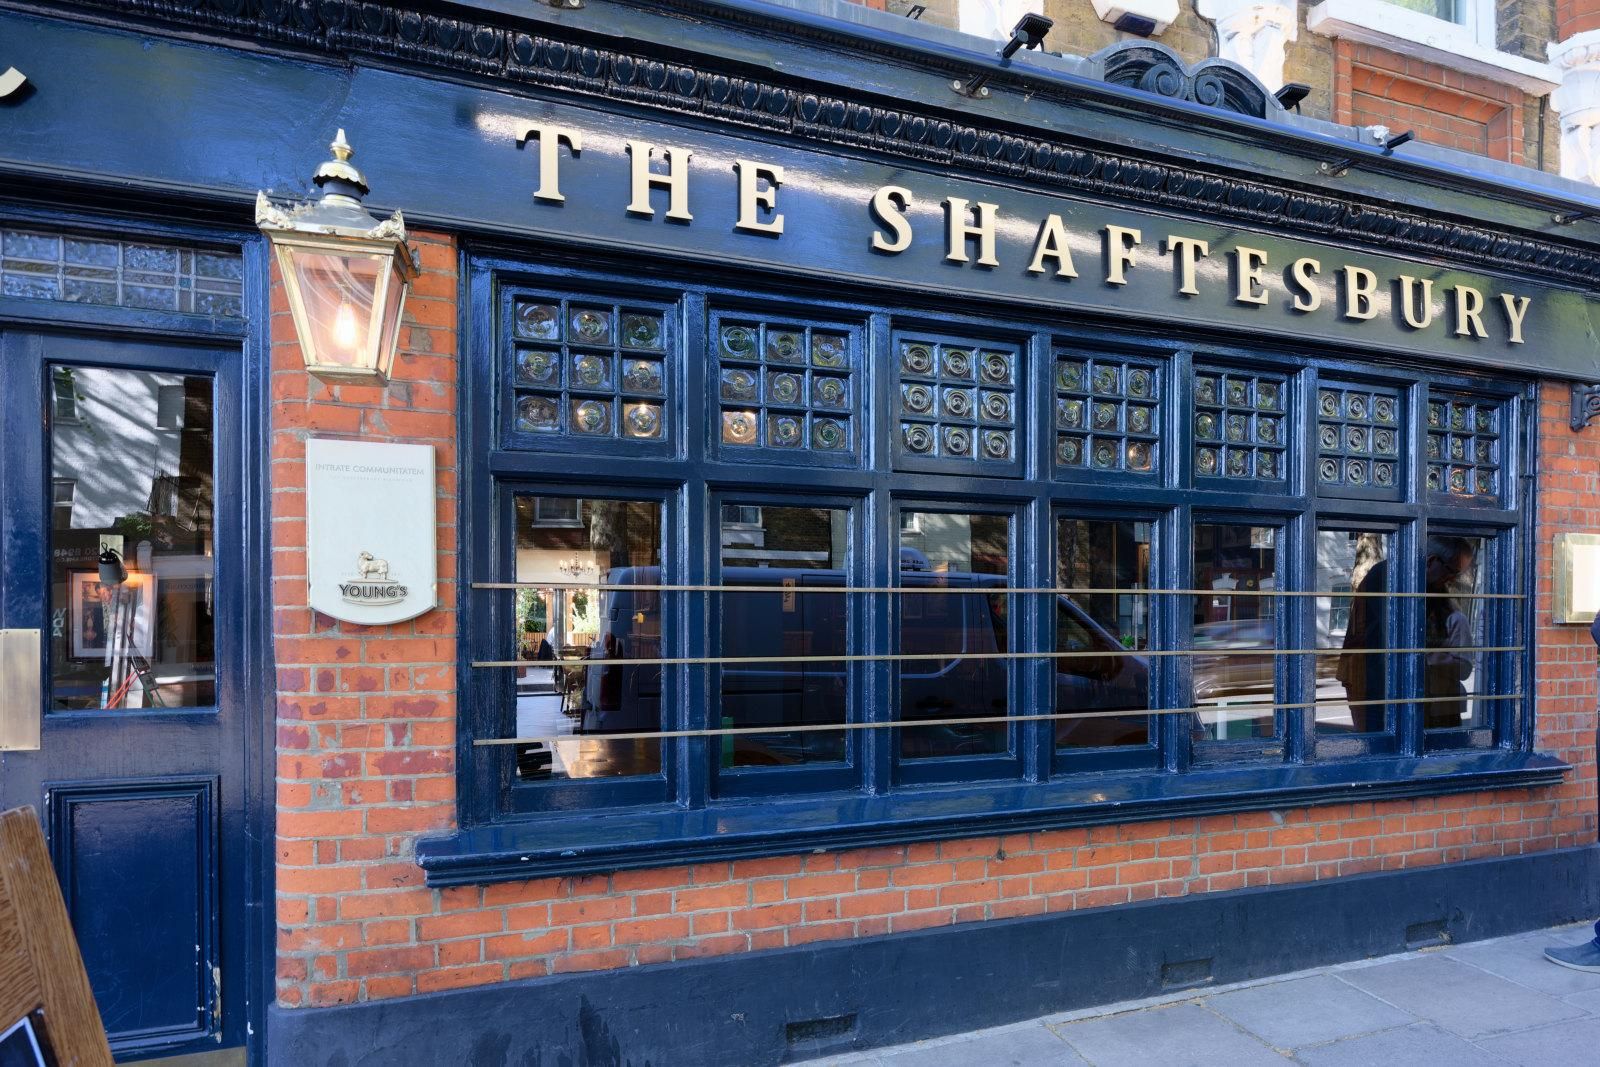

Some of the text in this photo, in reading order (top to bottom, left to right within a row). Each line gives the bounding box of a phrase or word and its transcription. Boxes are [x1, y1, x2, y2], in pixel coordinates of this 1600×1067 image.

[515, 122, 1532, 344] THE SHAFTESBURY
[315, 463, 424, 475] INTRATE COMMUNITATEM
[338, 583, 408, 599] YOUNG'S
